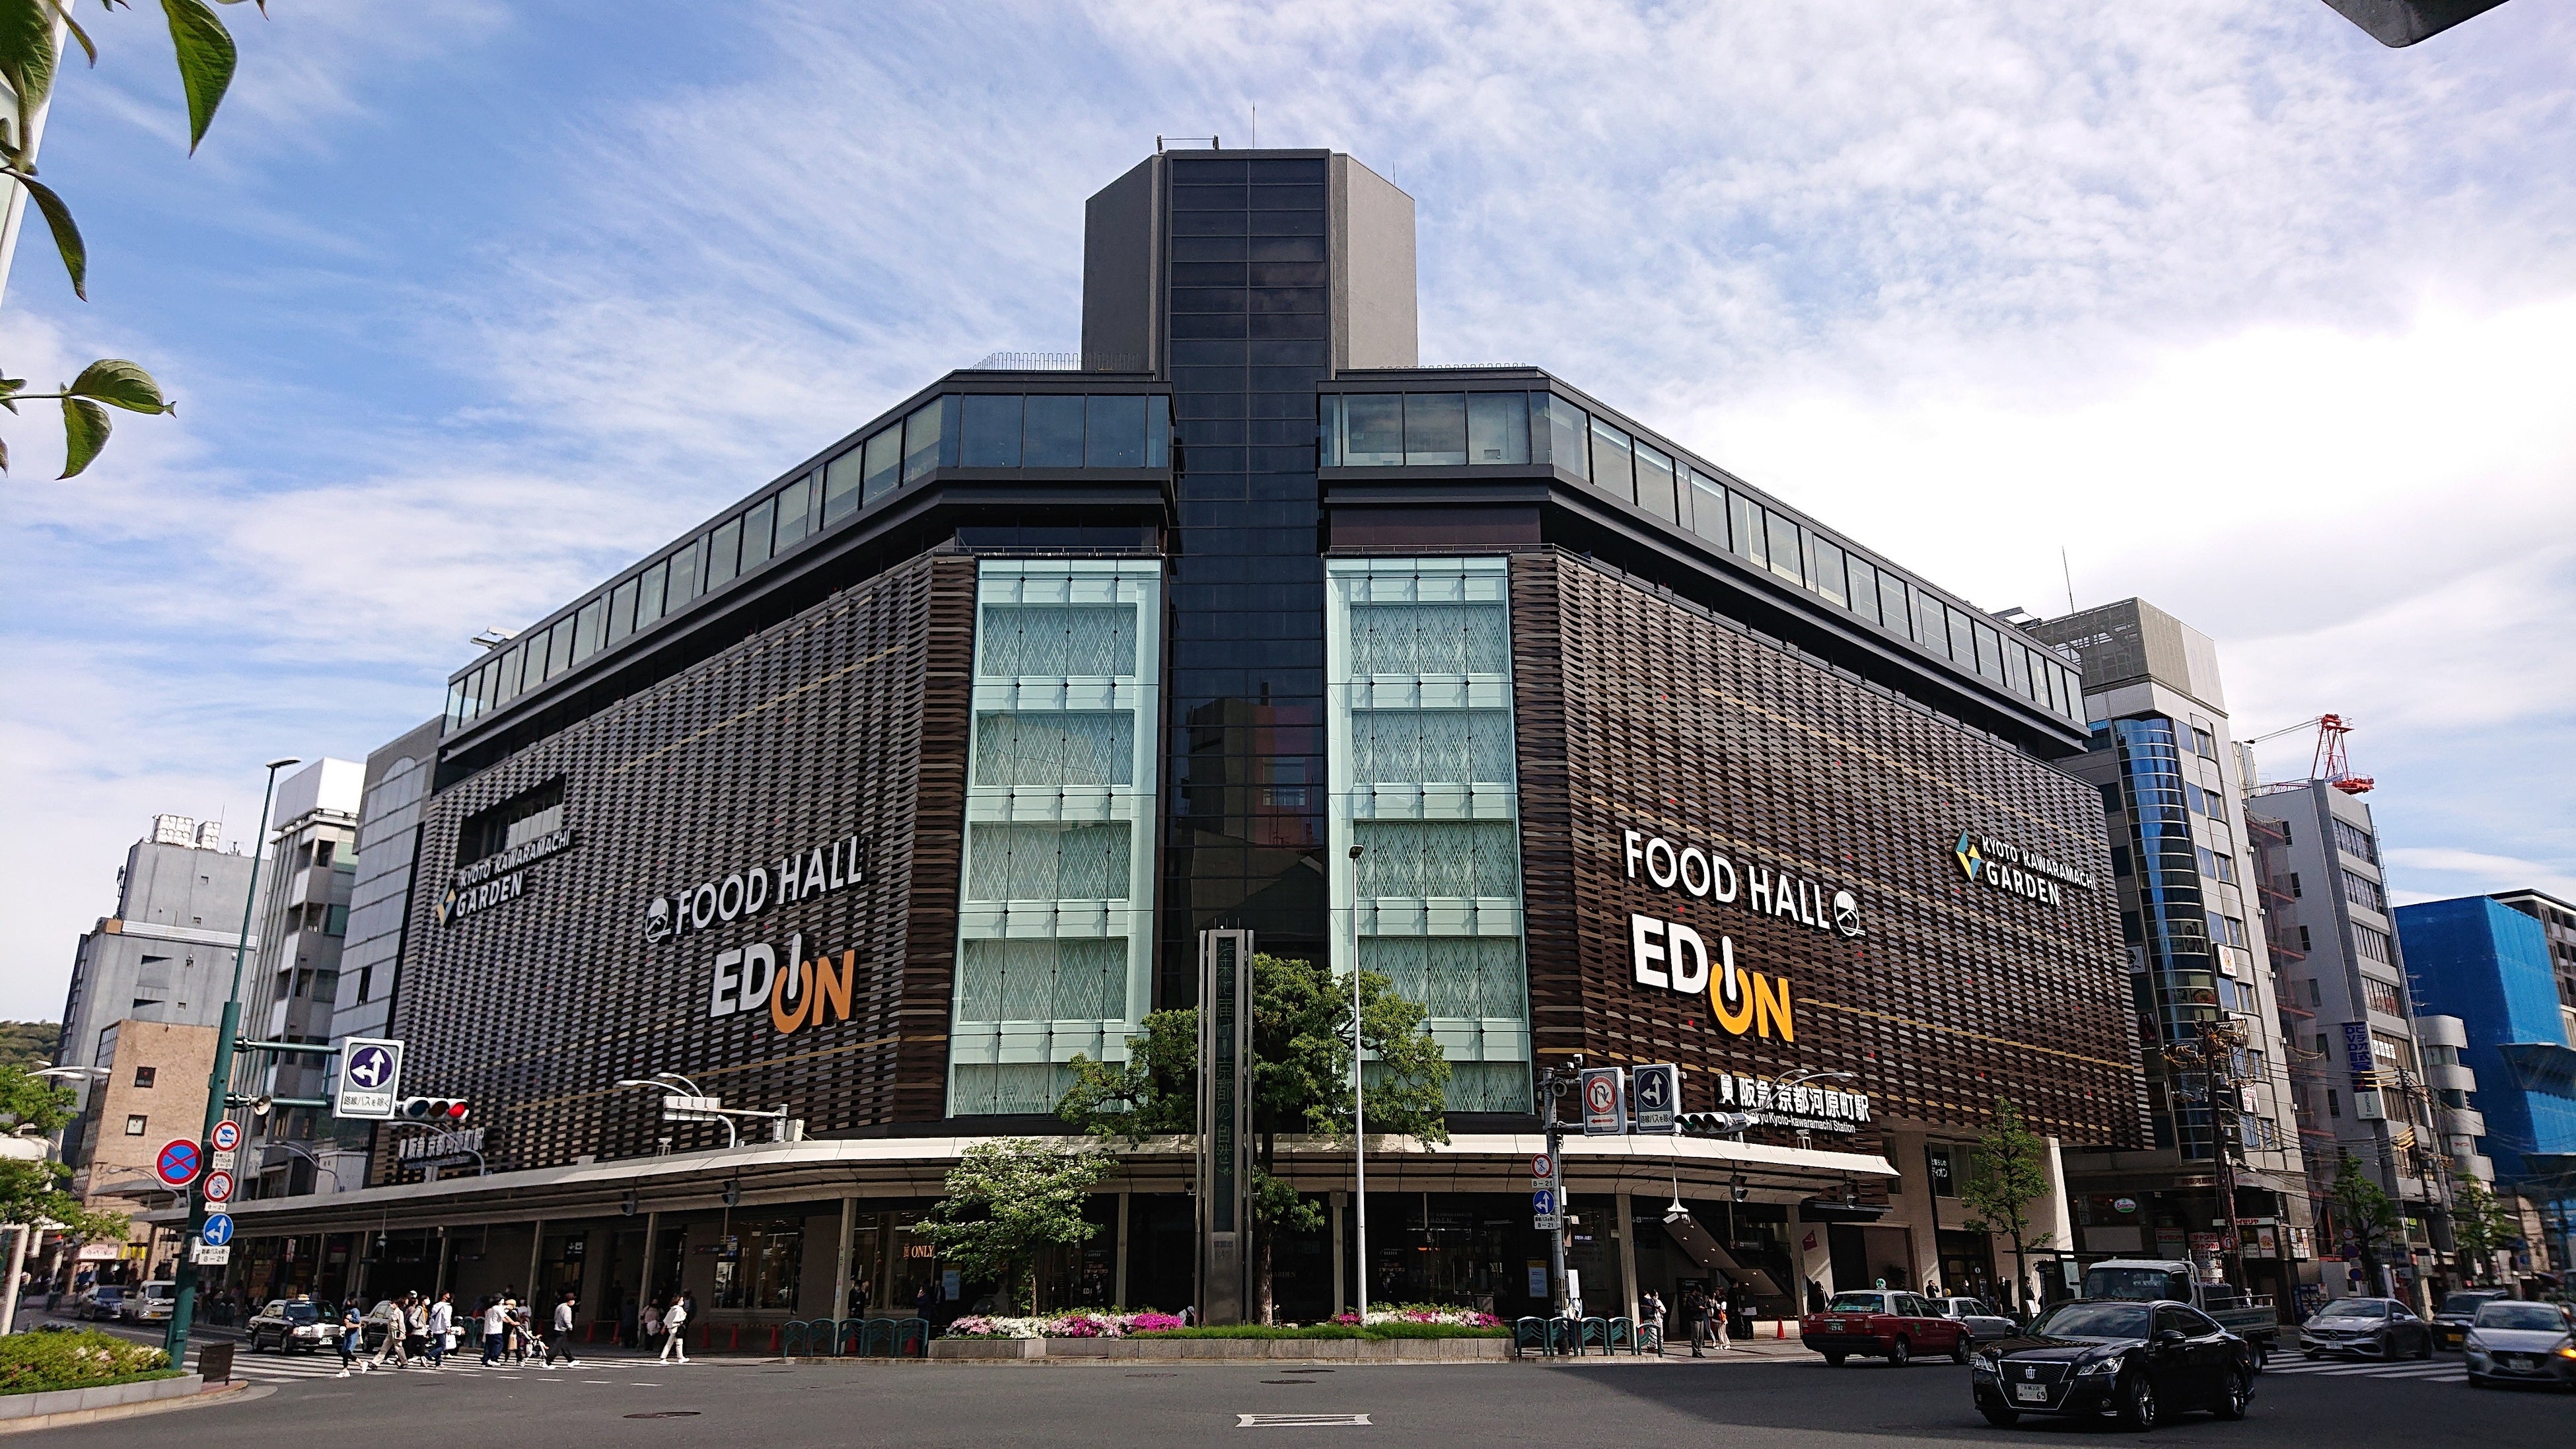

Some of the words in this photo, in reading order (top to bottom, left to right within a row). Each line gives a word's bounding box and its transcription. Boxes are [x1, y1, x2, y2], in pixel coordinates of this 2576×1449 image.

[460, 862, 491, 886] KYOTO
[495, 830, 571, 874] KAWARAMACHI
[676, 868, 767, 935] FOOD
[778, 836, 861, 904] HALL
[1625, 830, 1736, 903] FOOD
[1749, 865, 1830, 929] HALL
[1982, 835, 2018, 863] KYOTO
[2023, 851, 2097, 890] KAWARAMACHI
[1986, 861, 2060, 907] GARDEN
[456, 871, 523, 917] GARDEN
[710, 933, 855, 1034] EDION
[1631, 913, 1794, 1042] EDION
[1640, 1113, 1673, 1124] 路線バスを除く
[1768, 1112, 1833, 1131] Kyoto-kawaramachi
[1834, 1124, 1856, 1134] Station
[912, 1245, 935, 1257] ONLY
